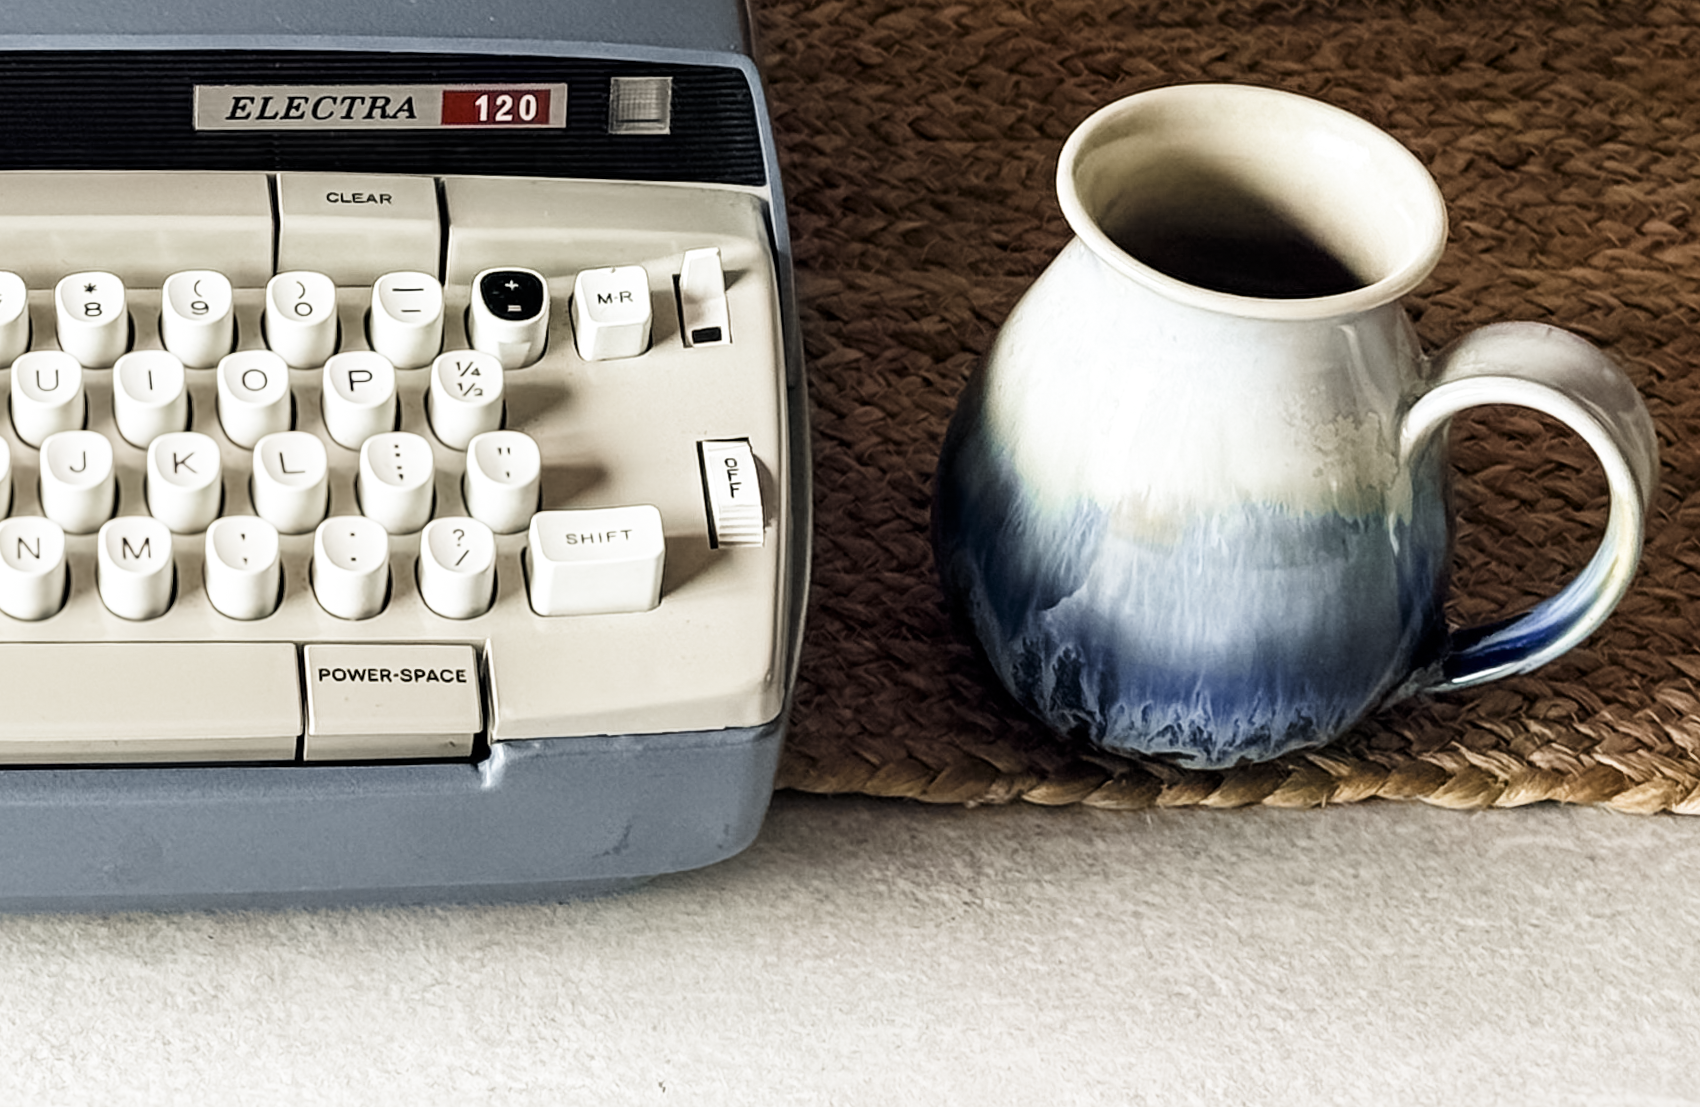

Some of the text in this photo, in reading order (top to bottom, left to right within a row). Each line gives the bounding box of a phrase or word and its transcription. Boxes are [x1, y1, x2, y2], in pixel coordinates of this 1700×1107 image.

[224, 93, 538, 122] ELECTRA 120
[325, 191, 393, 205] CLEAR
[83, 301, 103, 317] 8
[190, 300, 210, 316] 9
[35, 369, 60, 392] U
[147, 369, 154, 391] I
[240, 368, 269, 392] O
[347, 369, 374, 392] P
[68, 450, 88, 474] J
[172, 451, 198, 475] K
[278, 451, 306, 475] L
[723, 457, 743, 499] OFF
[16, 536, 42, 561] N
[120, 536, 152, 561] M
[451, 528, 466, 548] ?
[565, 528, 634, 546] SHIFT
[317, 666, 468, 684] POWER-SPACE
